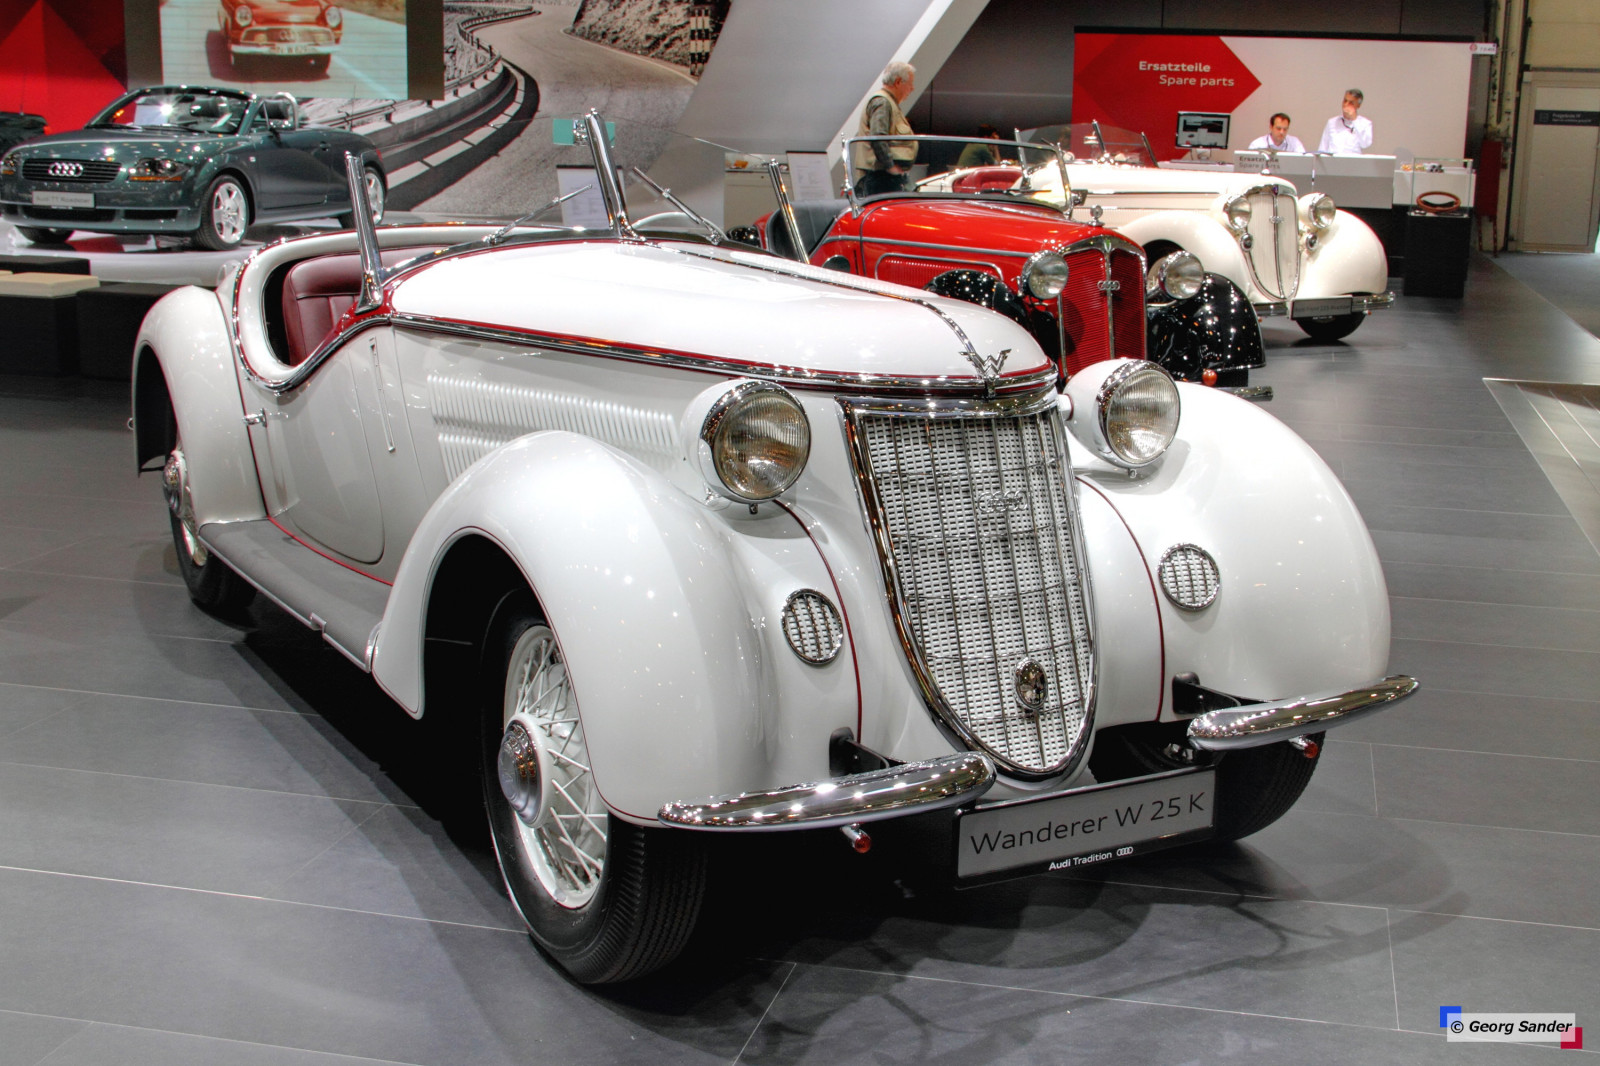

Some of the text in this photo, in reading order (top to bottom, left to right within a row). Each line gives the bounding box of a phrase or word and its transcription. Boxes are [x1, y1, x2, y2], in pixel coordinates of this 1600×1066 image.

[1138, 61, 1211, 73] Ersatzteile
[1159, 74, 1235, 88] Spare parts
[970, 792, 1205, 855] Wanderer W 25 K
[1049, 850, 1112, 871] Audi Tradition
